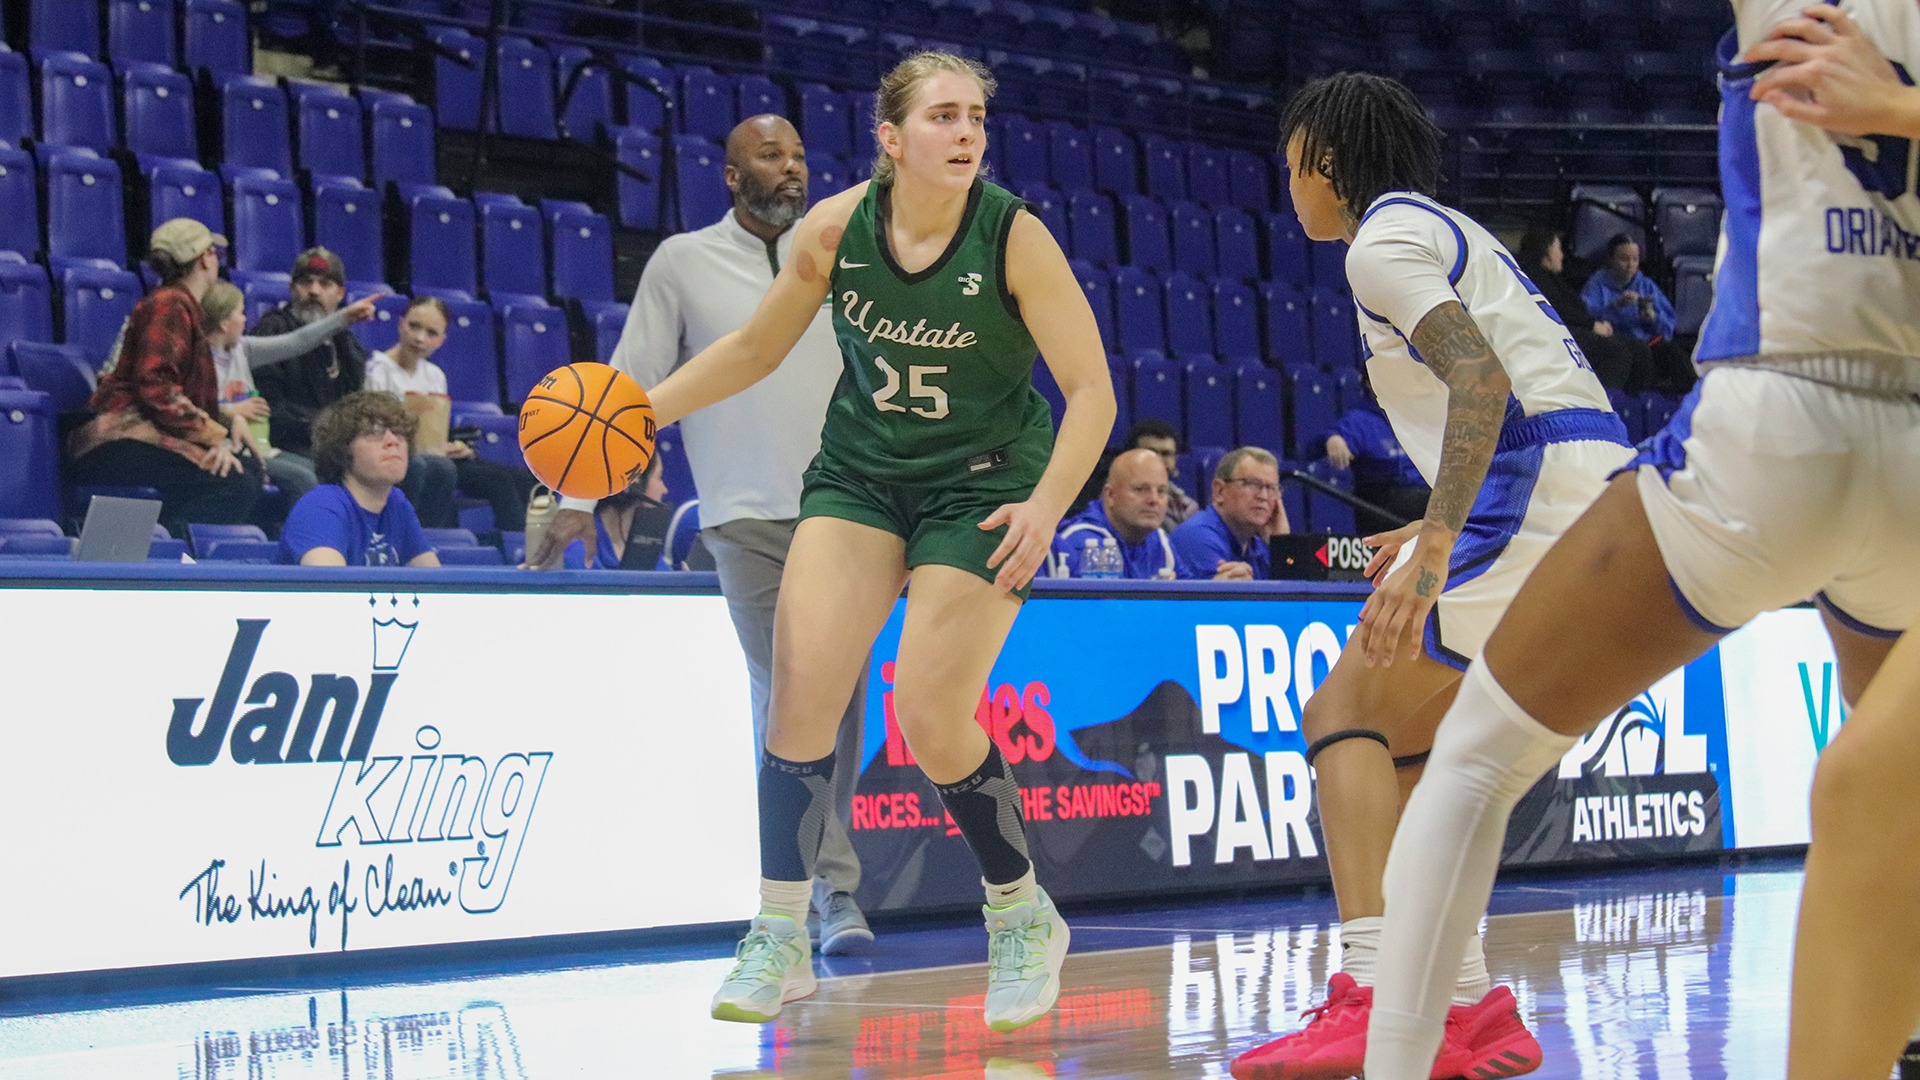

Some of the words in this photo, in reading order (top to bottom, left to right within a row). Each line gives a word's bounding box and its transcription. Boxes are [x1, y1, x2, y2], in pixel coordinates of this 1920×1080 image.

[842, 290, 978, 348] Upstate
[872, 355, 950, 420] 25
[166, 618, 399, 766] Jani
[1195, 622, 1364, 734] PRO
[315, 725, 554, 914] king
[851, 792, 940, 831] RICES...
[1165, 751, 1319, 867] PAR
[1572, 790, 1706, 842] ATHLETICS
[180, 858, 242, 926] The
[247, 858, 320, 949] King
[328, 859, 358, 951] of
